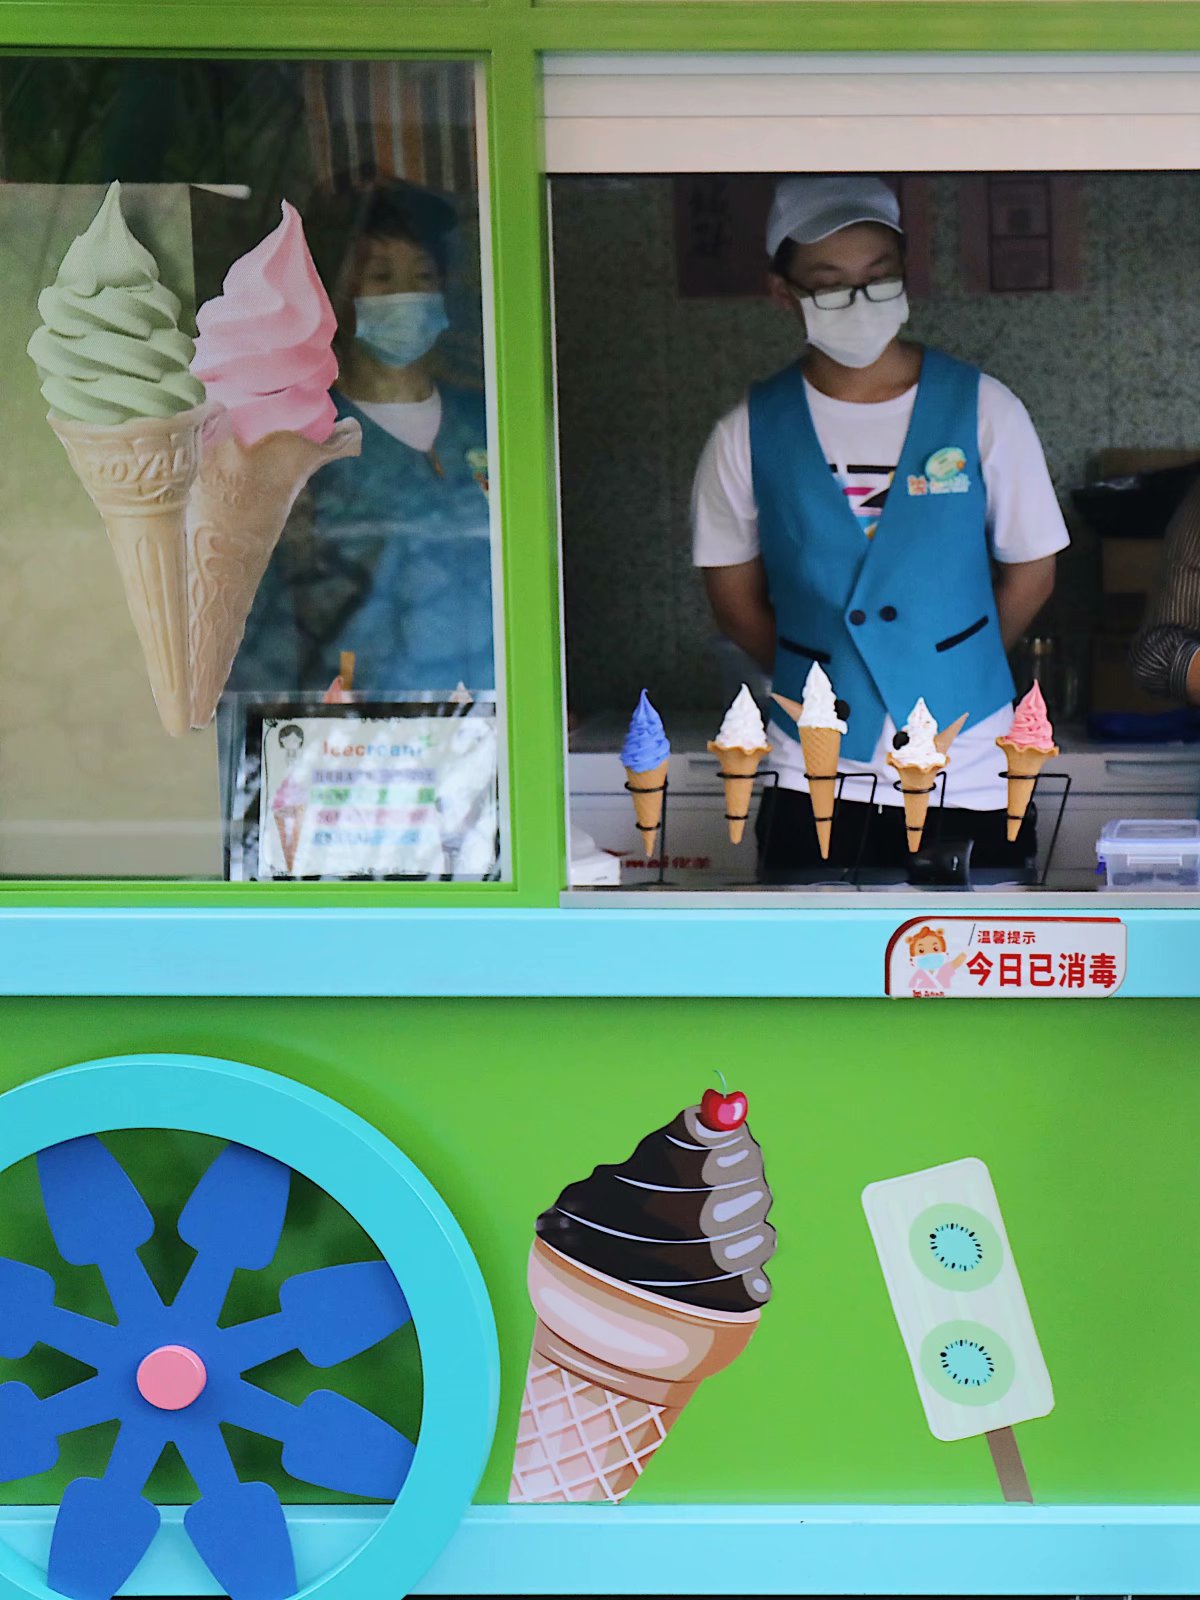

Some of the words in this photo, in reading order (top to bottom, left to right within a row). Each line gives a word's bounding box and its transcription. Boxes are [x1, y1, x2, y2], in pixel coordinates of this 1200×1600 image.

[977, 930, 1036, 945] 温馨提示
[966, 951, 1117, 988] 今日已消毒
